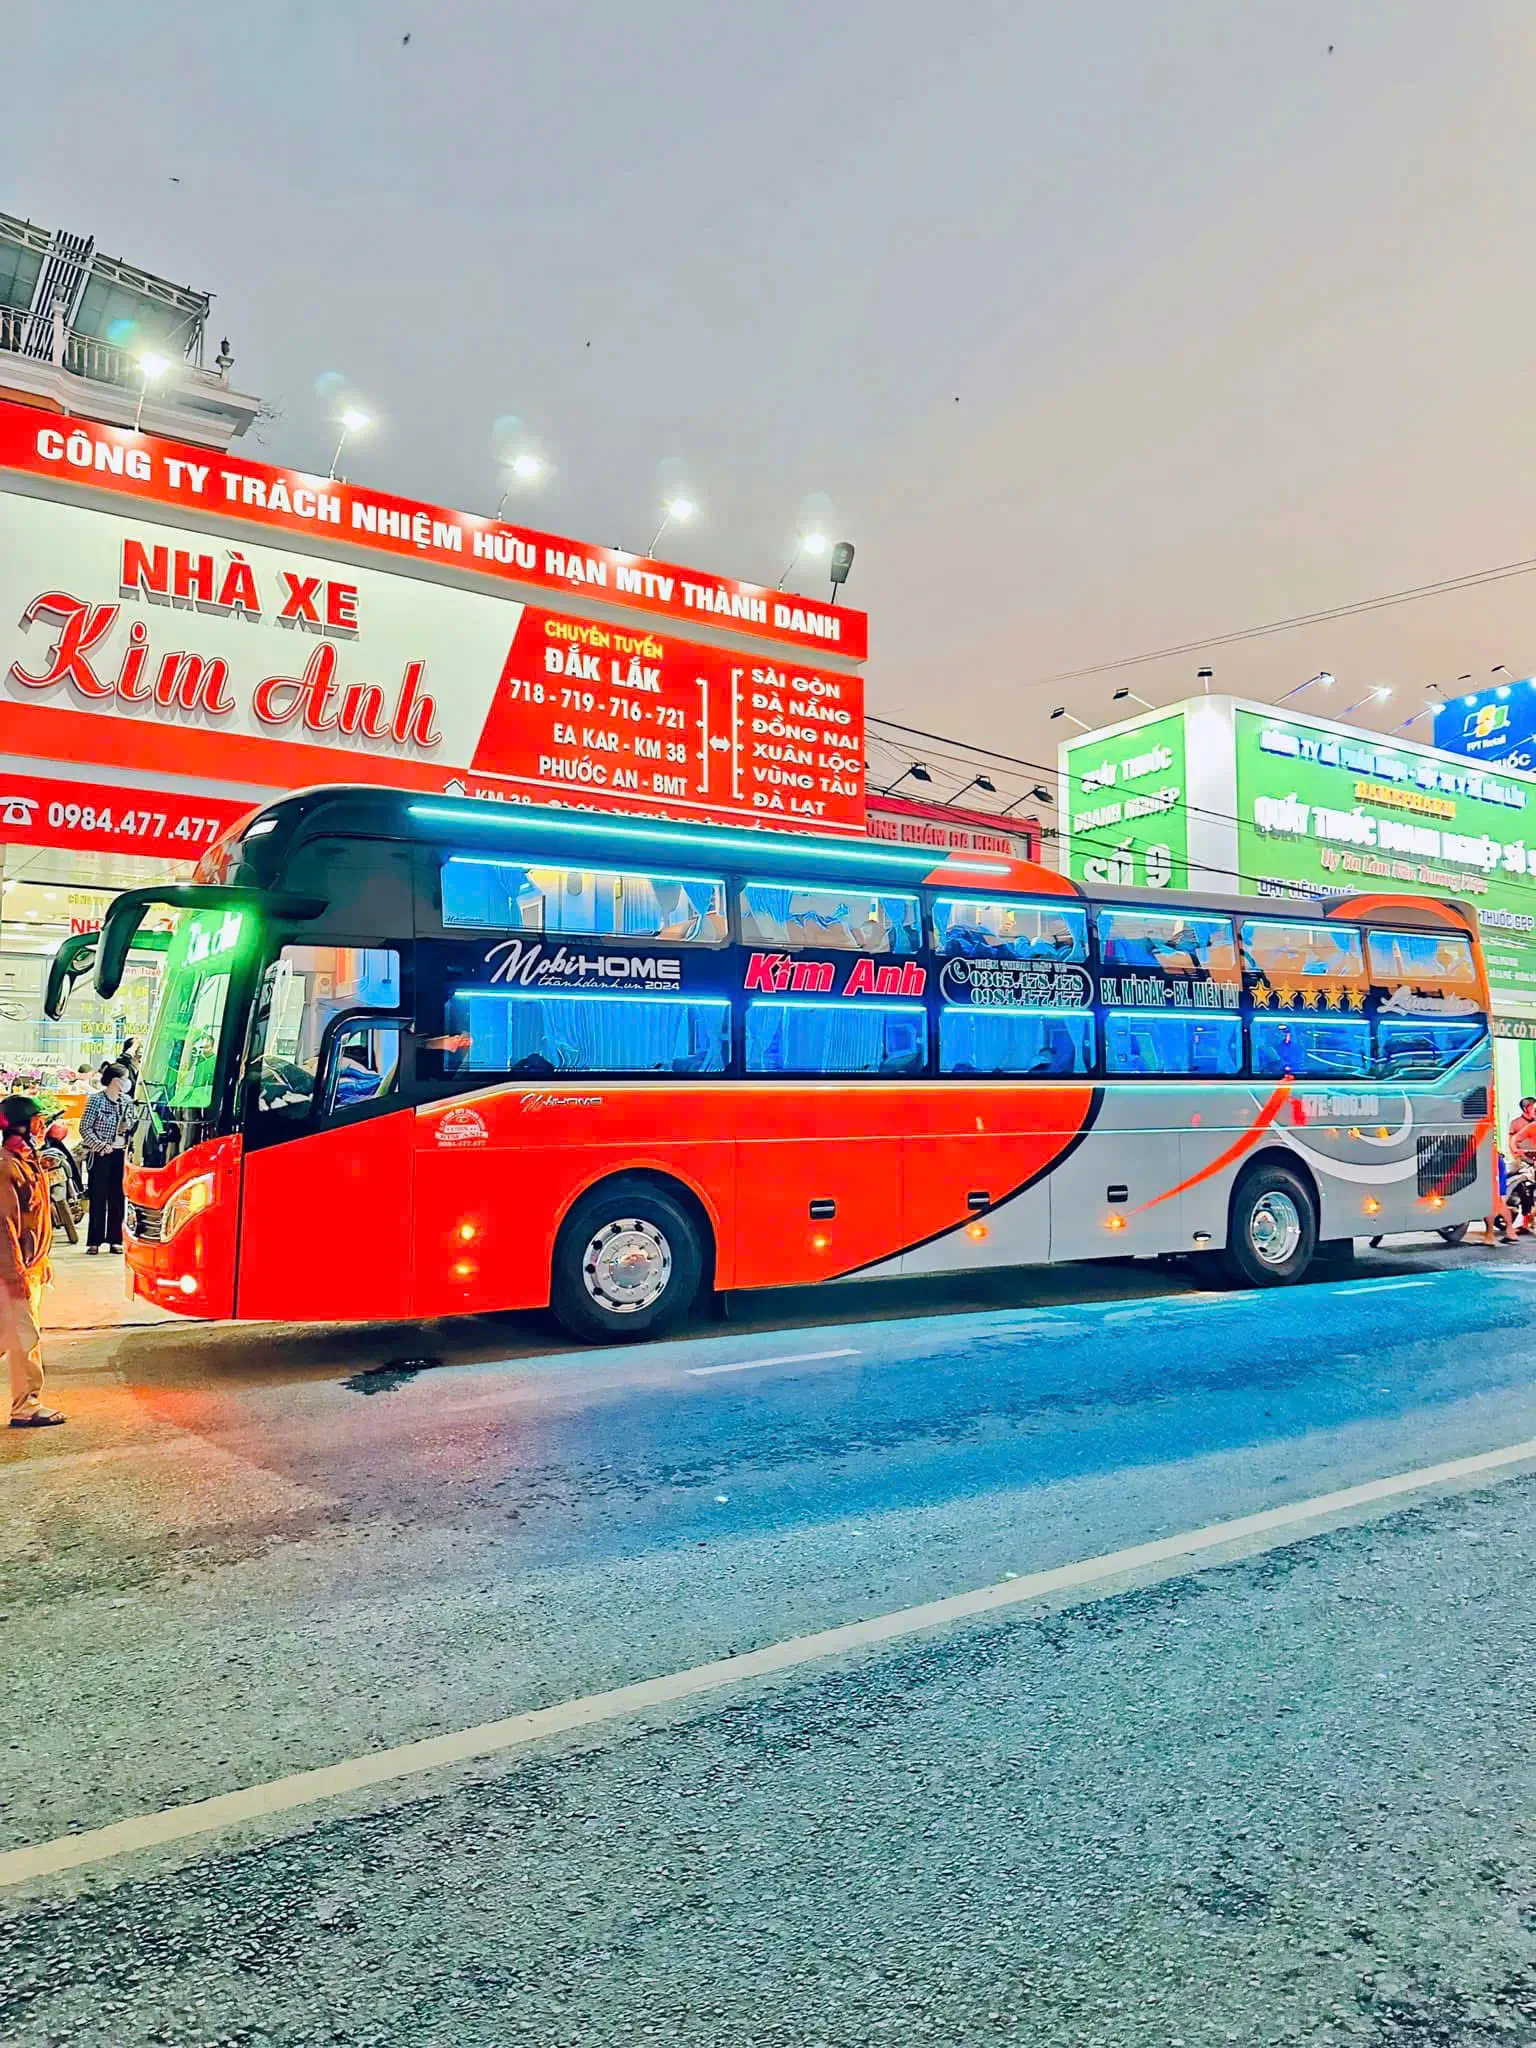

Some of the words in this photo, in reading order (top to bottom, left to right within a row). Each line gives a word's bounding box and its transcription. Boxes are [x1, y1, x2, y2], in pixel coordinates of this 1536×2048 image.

[36, 429, 152, 481] CÔNG
[163, 458, 209, 494] TY
[221, 471, 341, 525] TRÁCH
[351, 501, 463, 553] NHIỆM
[473, 530, 536, 569] HỮU
[545, 548, 607, 587] HẠN
[616, 566, 674, 603] MTV
[681, 581, 767, 625] THÀNH
[120, 538, 262, 620] NHÀ
[278, 571, 360, 634] XE
[545, 620, 611, 649] CHUYÊN
[613, 635, 664, 660] TUYẾN
[11, 590, 236, 716] Kim
[253, 641, 442, 749] Anh
[544, 643, 601, 682] ĐẮK
[611, 656, 662, 693] LẮK
[752, 667, 786, 689] SÀI
[791, 676, 841, 699] GÒN
[510, 678, 545, 704] 718
[560, 687, 595, 713] 719
[609, 696, 642, 722] 716
[655, 705, 686, 730] 721
[751, 691, 784, 713] ĐÀ
[553, 722, 577, 745] EA
[582, 727, 619, 753] KAR
[634, 736, 662, 760] KM
[665, 742, 687, 764] 38
[751, 714, 818, 743] ĐỒNG
[823, 730, 860, 751] NAI
[538, 754, 607, 785] PHƯỚC
[612, 767, 638, 790] AN
[653, 772, 688, 797] BMT
[752, 742, 813, 766] XUÂN
[818, 752, 861, 775] LỘC
[752, 789, 785, 811] ĐÀ
[790, 797, 827, 818] LẠT
[818, 774, 858, 797] TÀU
[48, 801, 221, 844] 0984.477.477
[484, 939, 681, 986] MobiHOME
[743, 952, 836, 994] Kim
[842, 958, 927, 997] Anh
[645, 980, 681, 991] 2024
